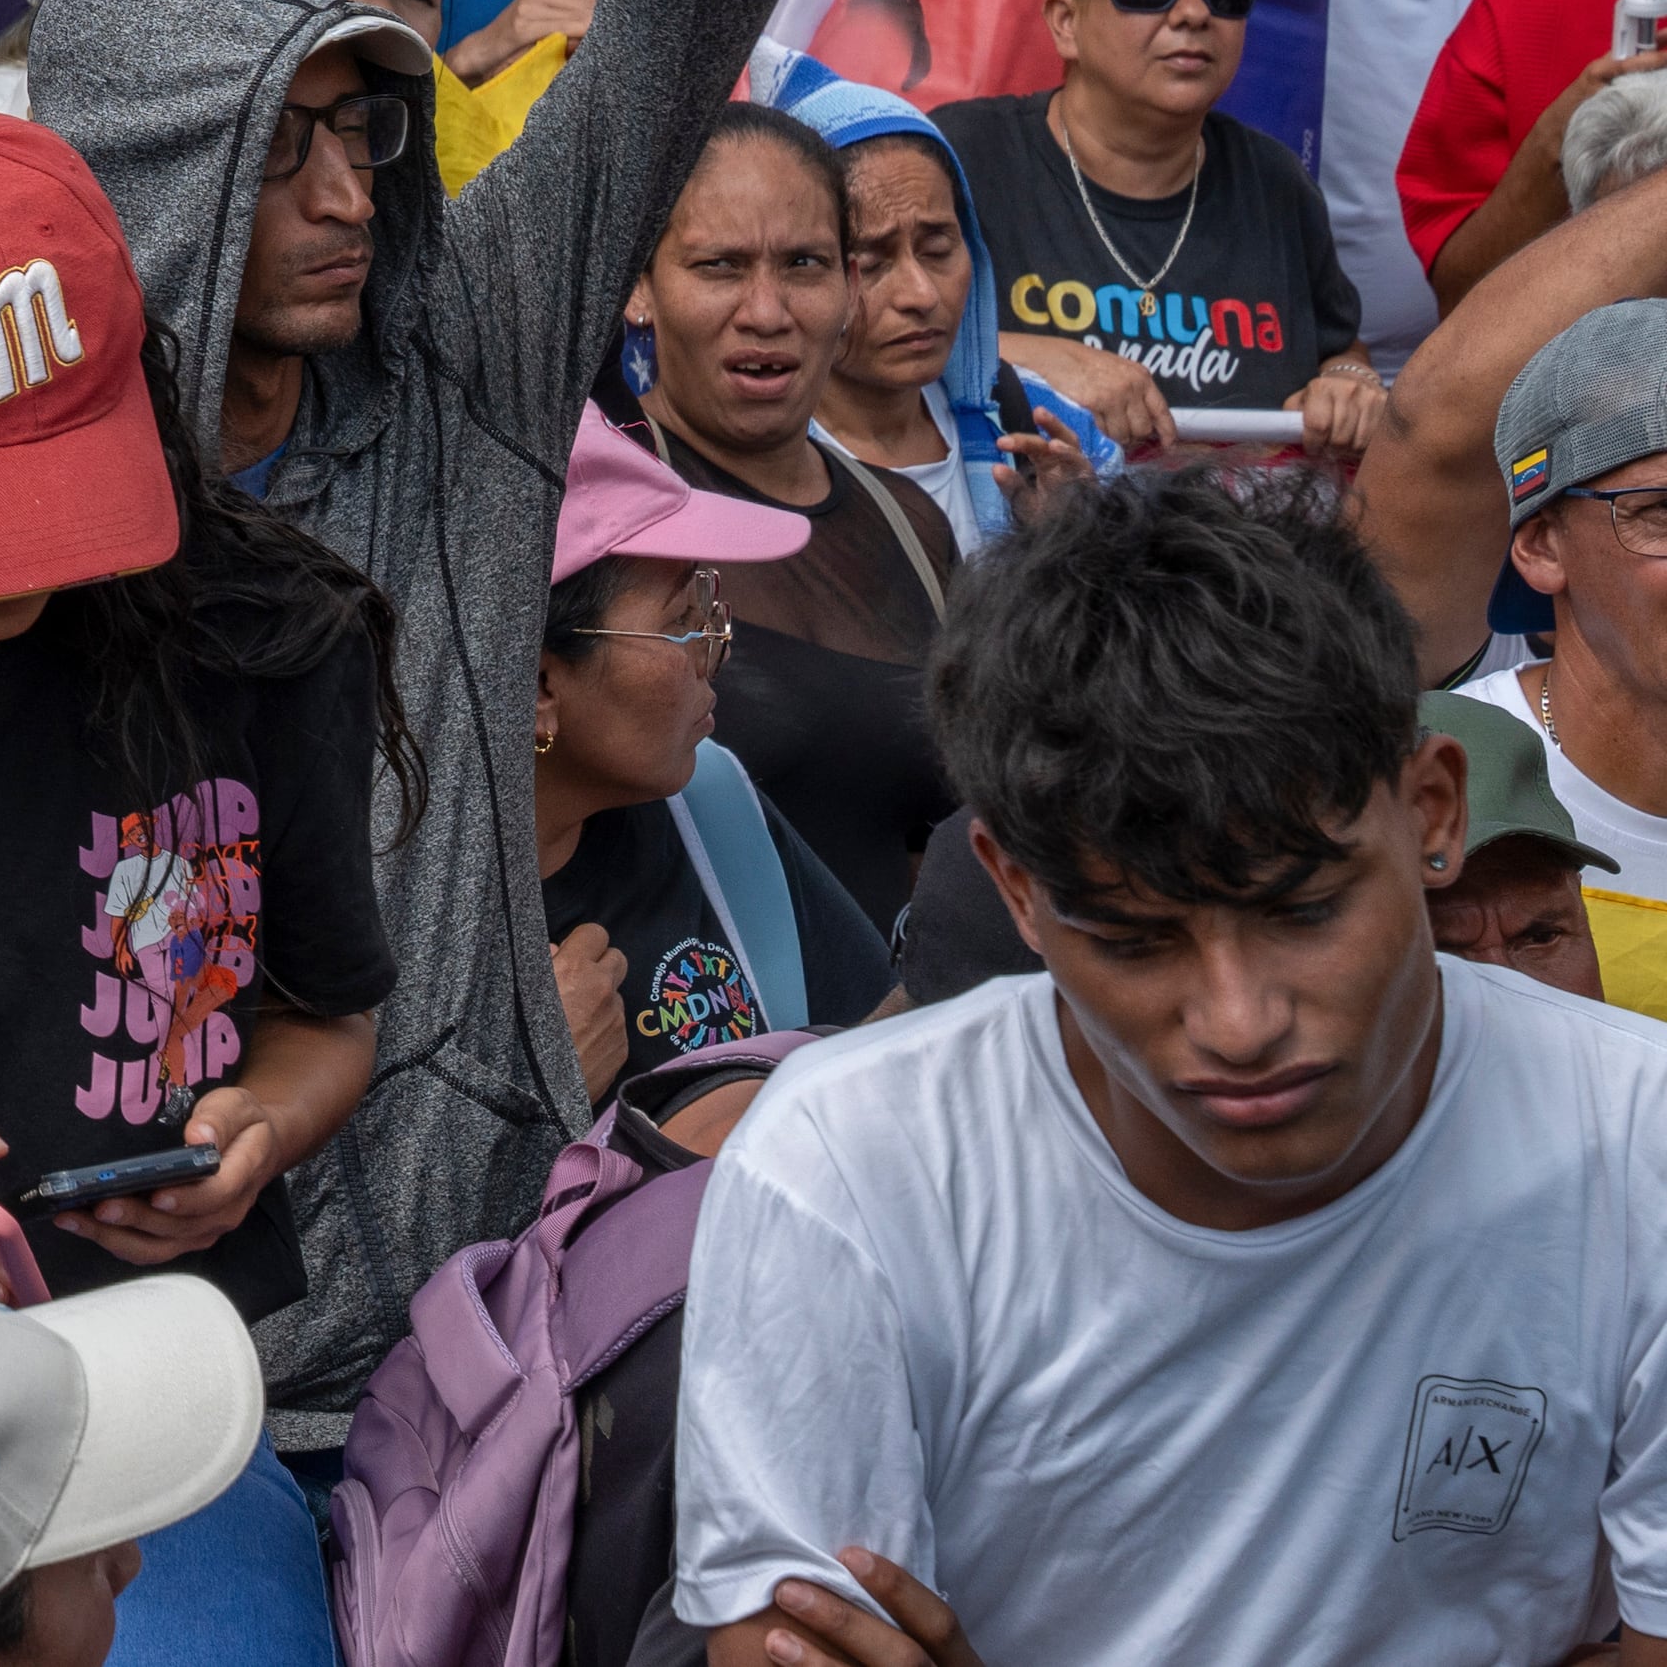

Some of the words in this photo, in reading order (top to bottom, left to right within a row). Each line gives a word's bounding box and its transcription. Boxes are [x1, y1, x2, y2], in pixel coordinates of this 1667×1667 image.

[1010, 272, 1285, 354] comuna
[649, 962, 668, 1002] Consejo
[661, 936, 701, 964] Municip
